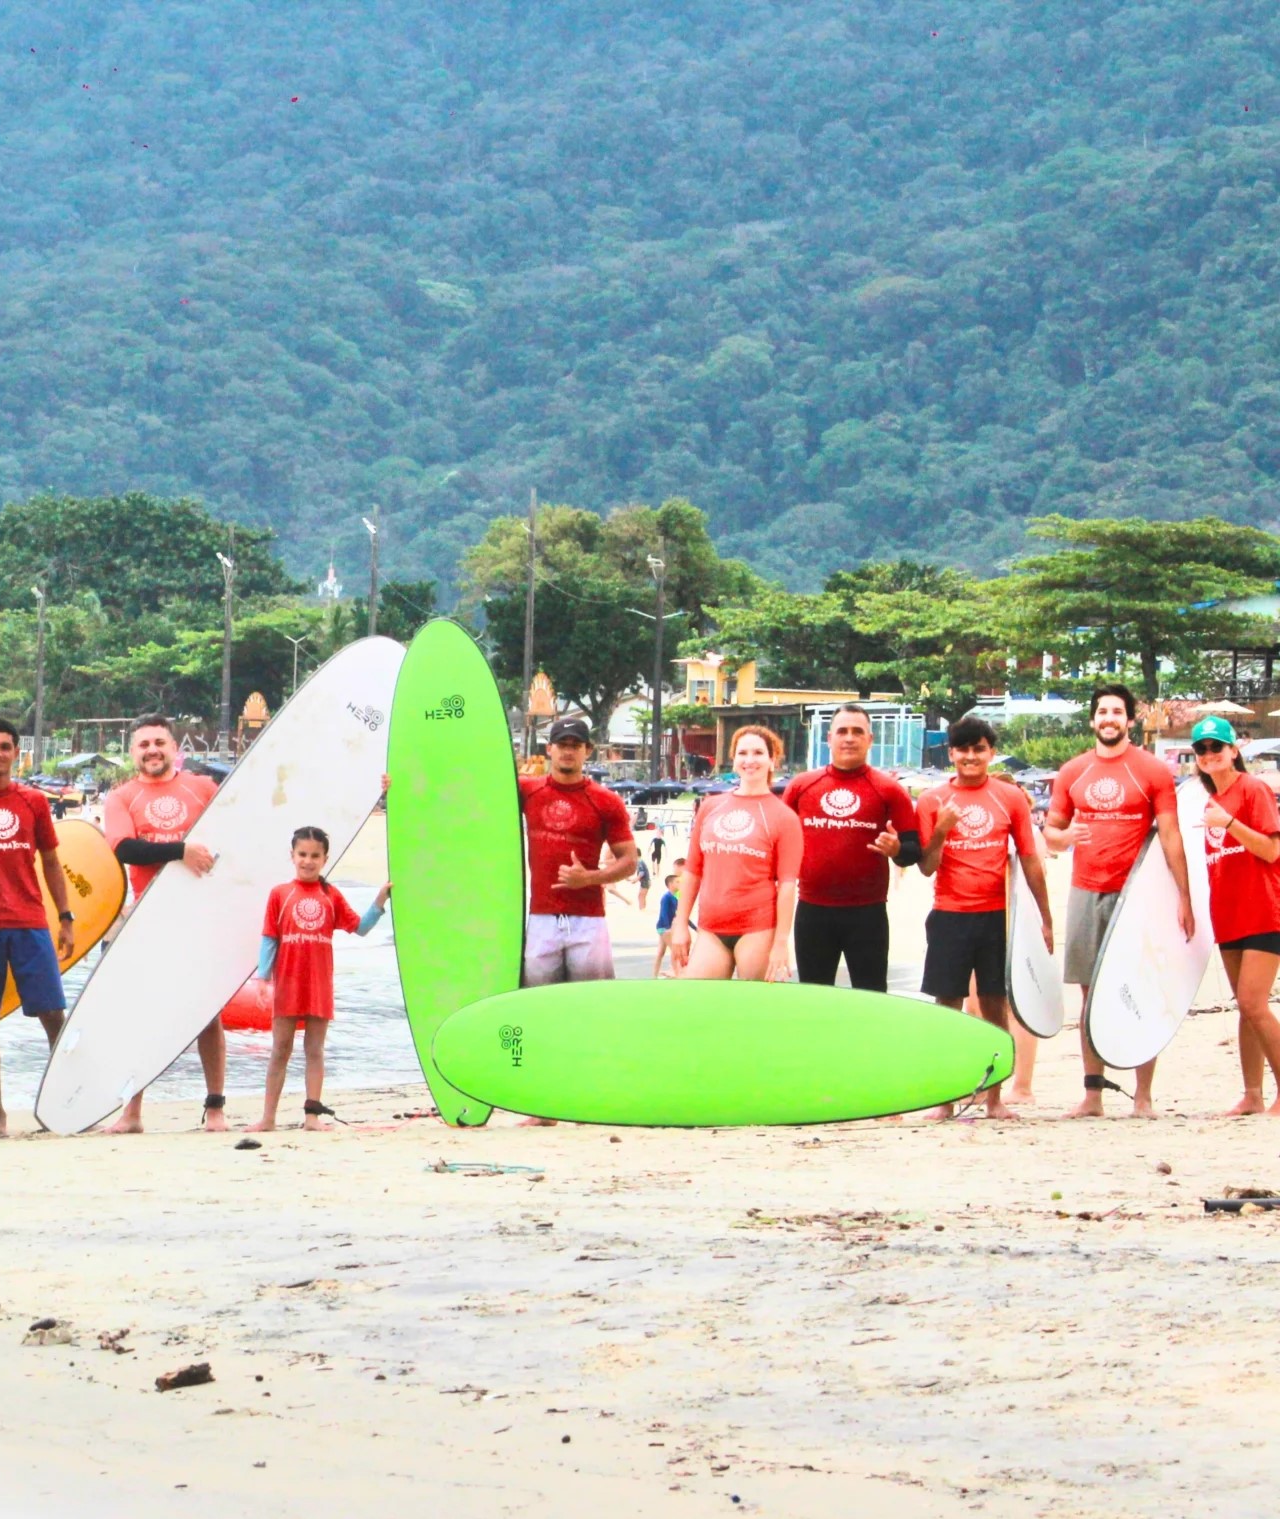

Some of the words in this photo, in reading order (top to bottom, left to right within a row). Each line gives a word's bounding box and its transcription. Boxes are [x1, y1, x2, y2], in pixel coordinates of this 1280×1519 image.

[346, 702, 379, 732] HERO
[424, 708, 465, 720] HERO
[803, 816, 828, 828] SURF
[827, 818, 850, 829] PARA
[849, 818, 877, 829] TODOS
[716, 842, 739, 855] PARA
[738, 843, 767, 859] TODOS
[1220, 845, 1245, 857] TODOS
[512, 1026, 524, 1067] HERO
